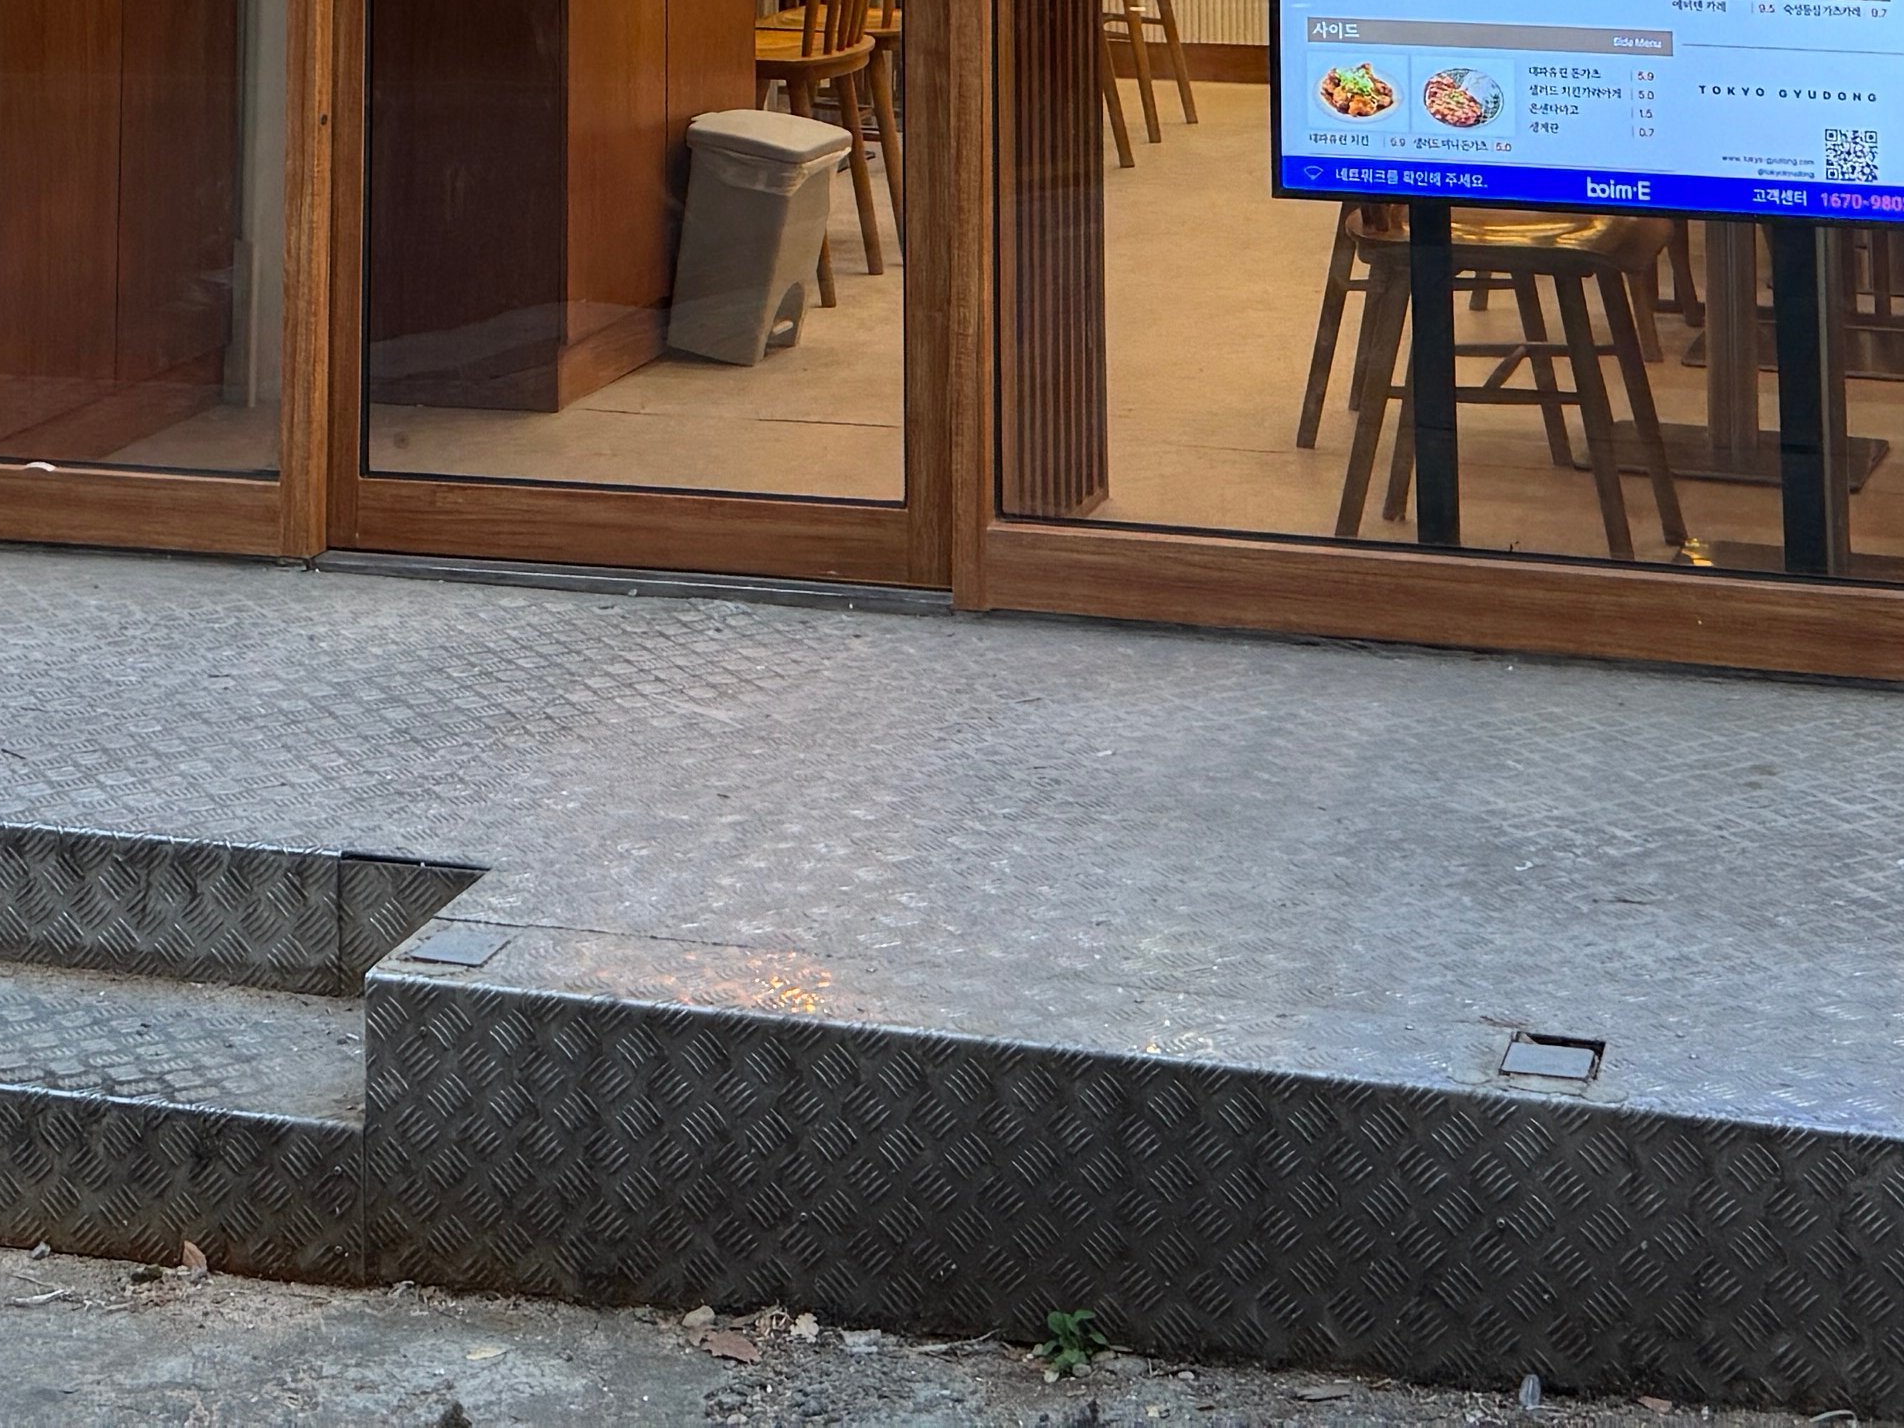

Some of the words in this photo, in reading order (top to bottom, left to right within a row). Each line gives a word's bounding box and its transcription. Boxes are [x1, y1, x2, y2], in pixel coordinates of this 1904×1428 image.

[1312, 21, 1360, 40] 사이드
[1698, 84, 1765, 97] TOKYO
[1778, 89, 1878, 103] GYUDONG
[1335, 167, 1399, 186] 네트워크를
[1402, 169, 1441, 188] 확인해
[1445, 172, 1488, 189] 주세요.
[1752, 189, 1808, 207] 고객센터
